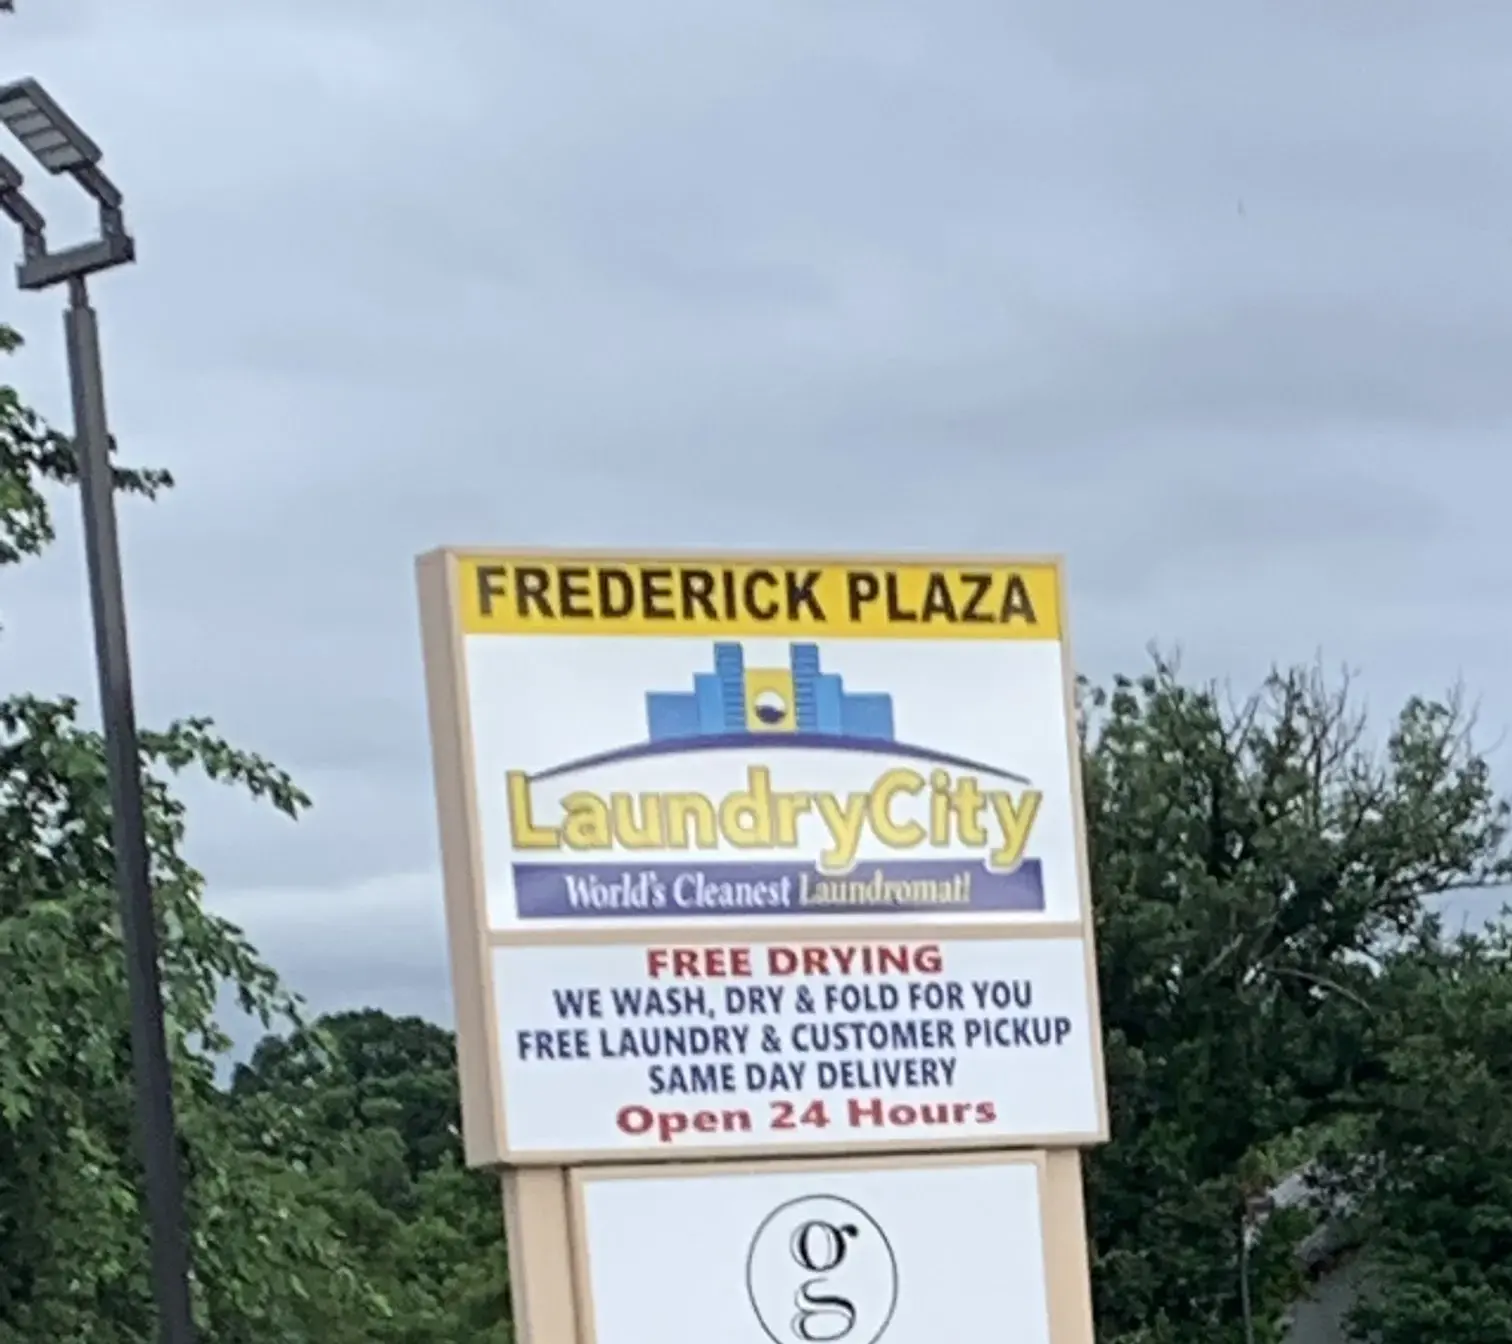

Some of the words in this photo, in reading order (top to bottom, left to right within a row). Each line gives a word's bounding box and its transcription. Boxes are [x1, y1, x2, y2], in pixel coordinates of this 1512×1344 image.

[475, 565, 827, 622] FREDERICK
[847, 569, 1037, 625] PLAZA
[506, 765, 1043, 869] LaundryCity
[565, 870, 666, 909] World's
[673, 870, 792, 909] Cleanest
[799, 870, 972, 907] Laundromat!
[646, 947, 752, 979] FREE
[768, 944, 943, 977] DRYING
[552, 988, 603, 1018] WE
[611, 986, 716, 1019] WASH,
[724, 984, 785, 1015] DRY
[794, 984, 815, 1014] &
[825, 982, 899, 1014] FOLD
[909, 981, 964, 1012] FOR
[972, 980, 1032, 1009] YOU
[516, 1029, 590, 1061] FREE
[600, 1024, 749, 1057] LAUNDRY
[760, 1023, 782, 1054] &
[790, 1019, 955, 1053] CUSTOMER
[964, 1015, 1073, 1048] PICKUP
[648, 1062, 736, 1094] SAME
[745, 1061, 806, 1091] DAY
[818, 1056, 957, 1090] DELIVERY
[616, 1104, 752, 1142] Open
[769, 1099, 830, 1129] 24
[847, 1098, 997, 1129] Hours
